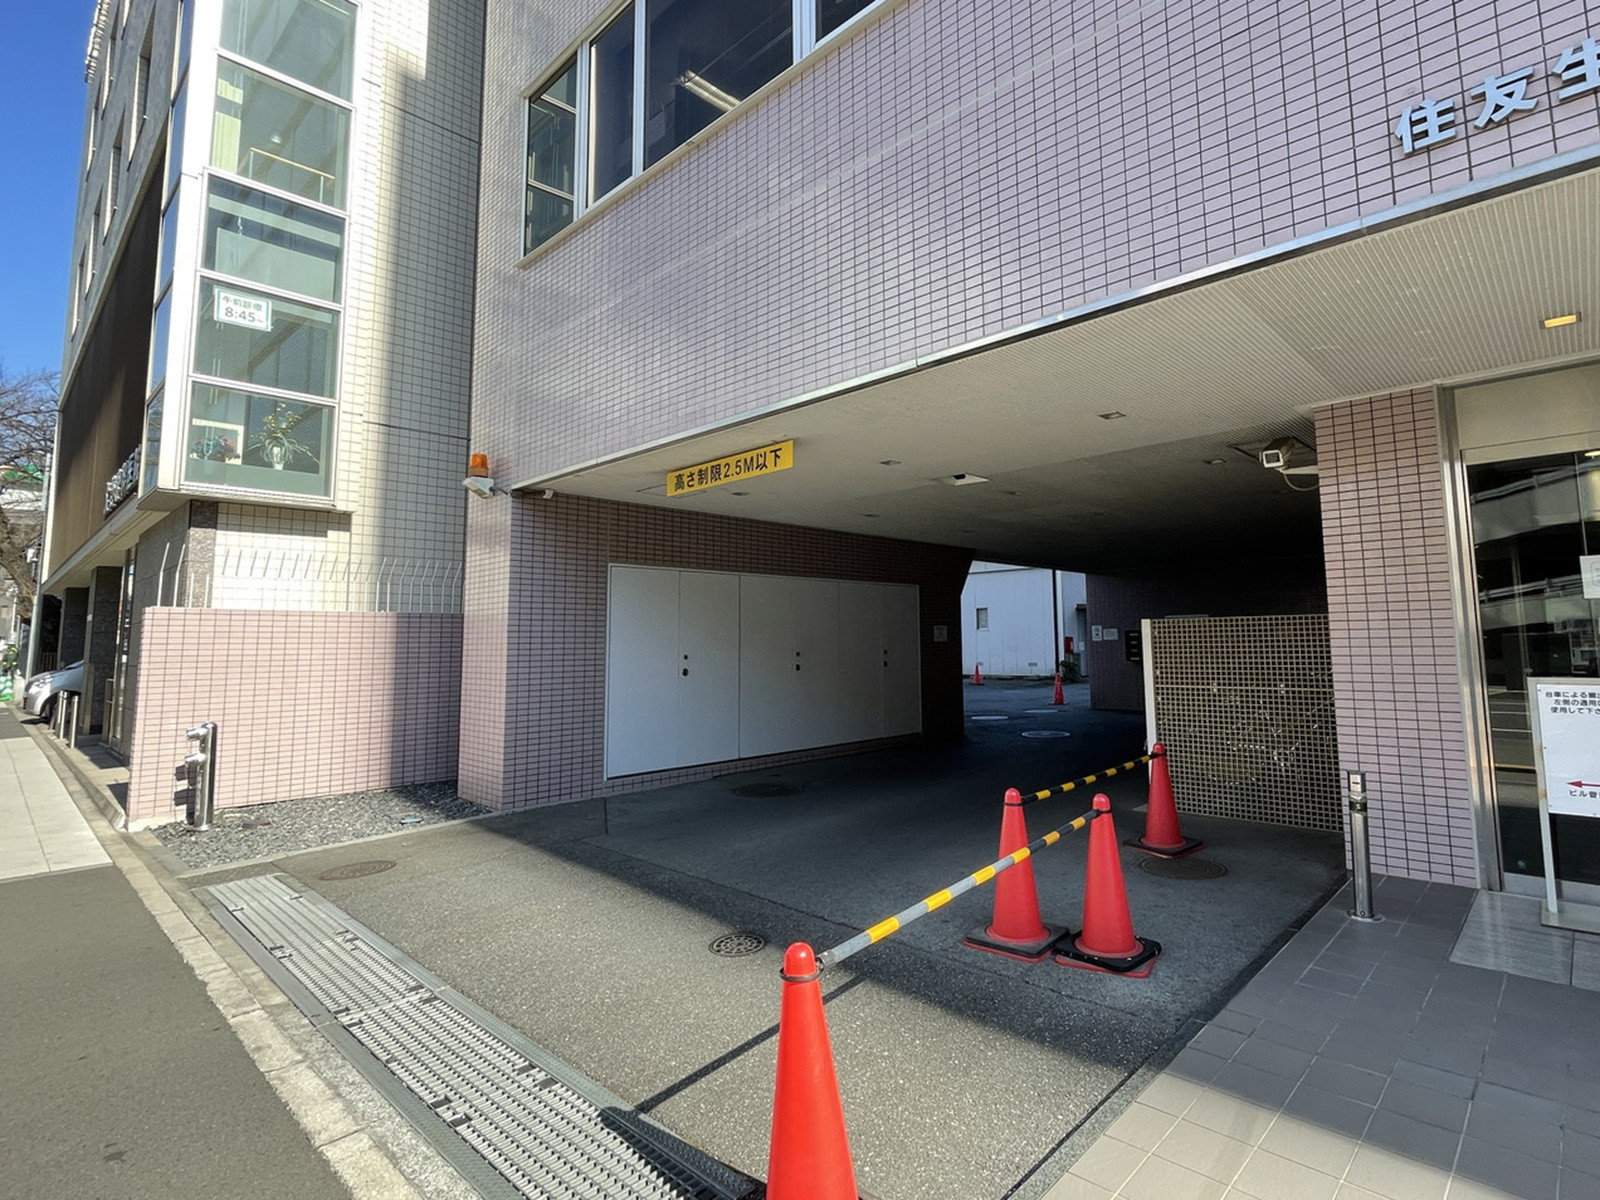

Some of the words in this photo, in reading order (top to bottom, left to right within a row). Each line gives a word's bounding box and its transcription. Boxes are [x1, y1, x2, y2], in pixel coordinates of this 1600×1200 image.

[1394, 37, 1600, 156] 住友生
[674, 448, 783, 492] 高さ制限2.5M以下
[1569, 789, 1600, 799] ビル管
